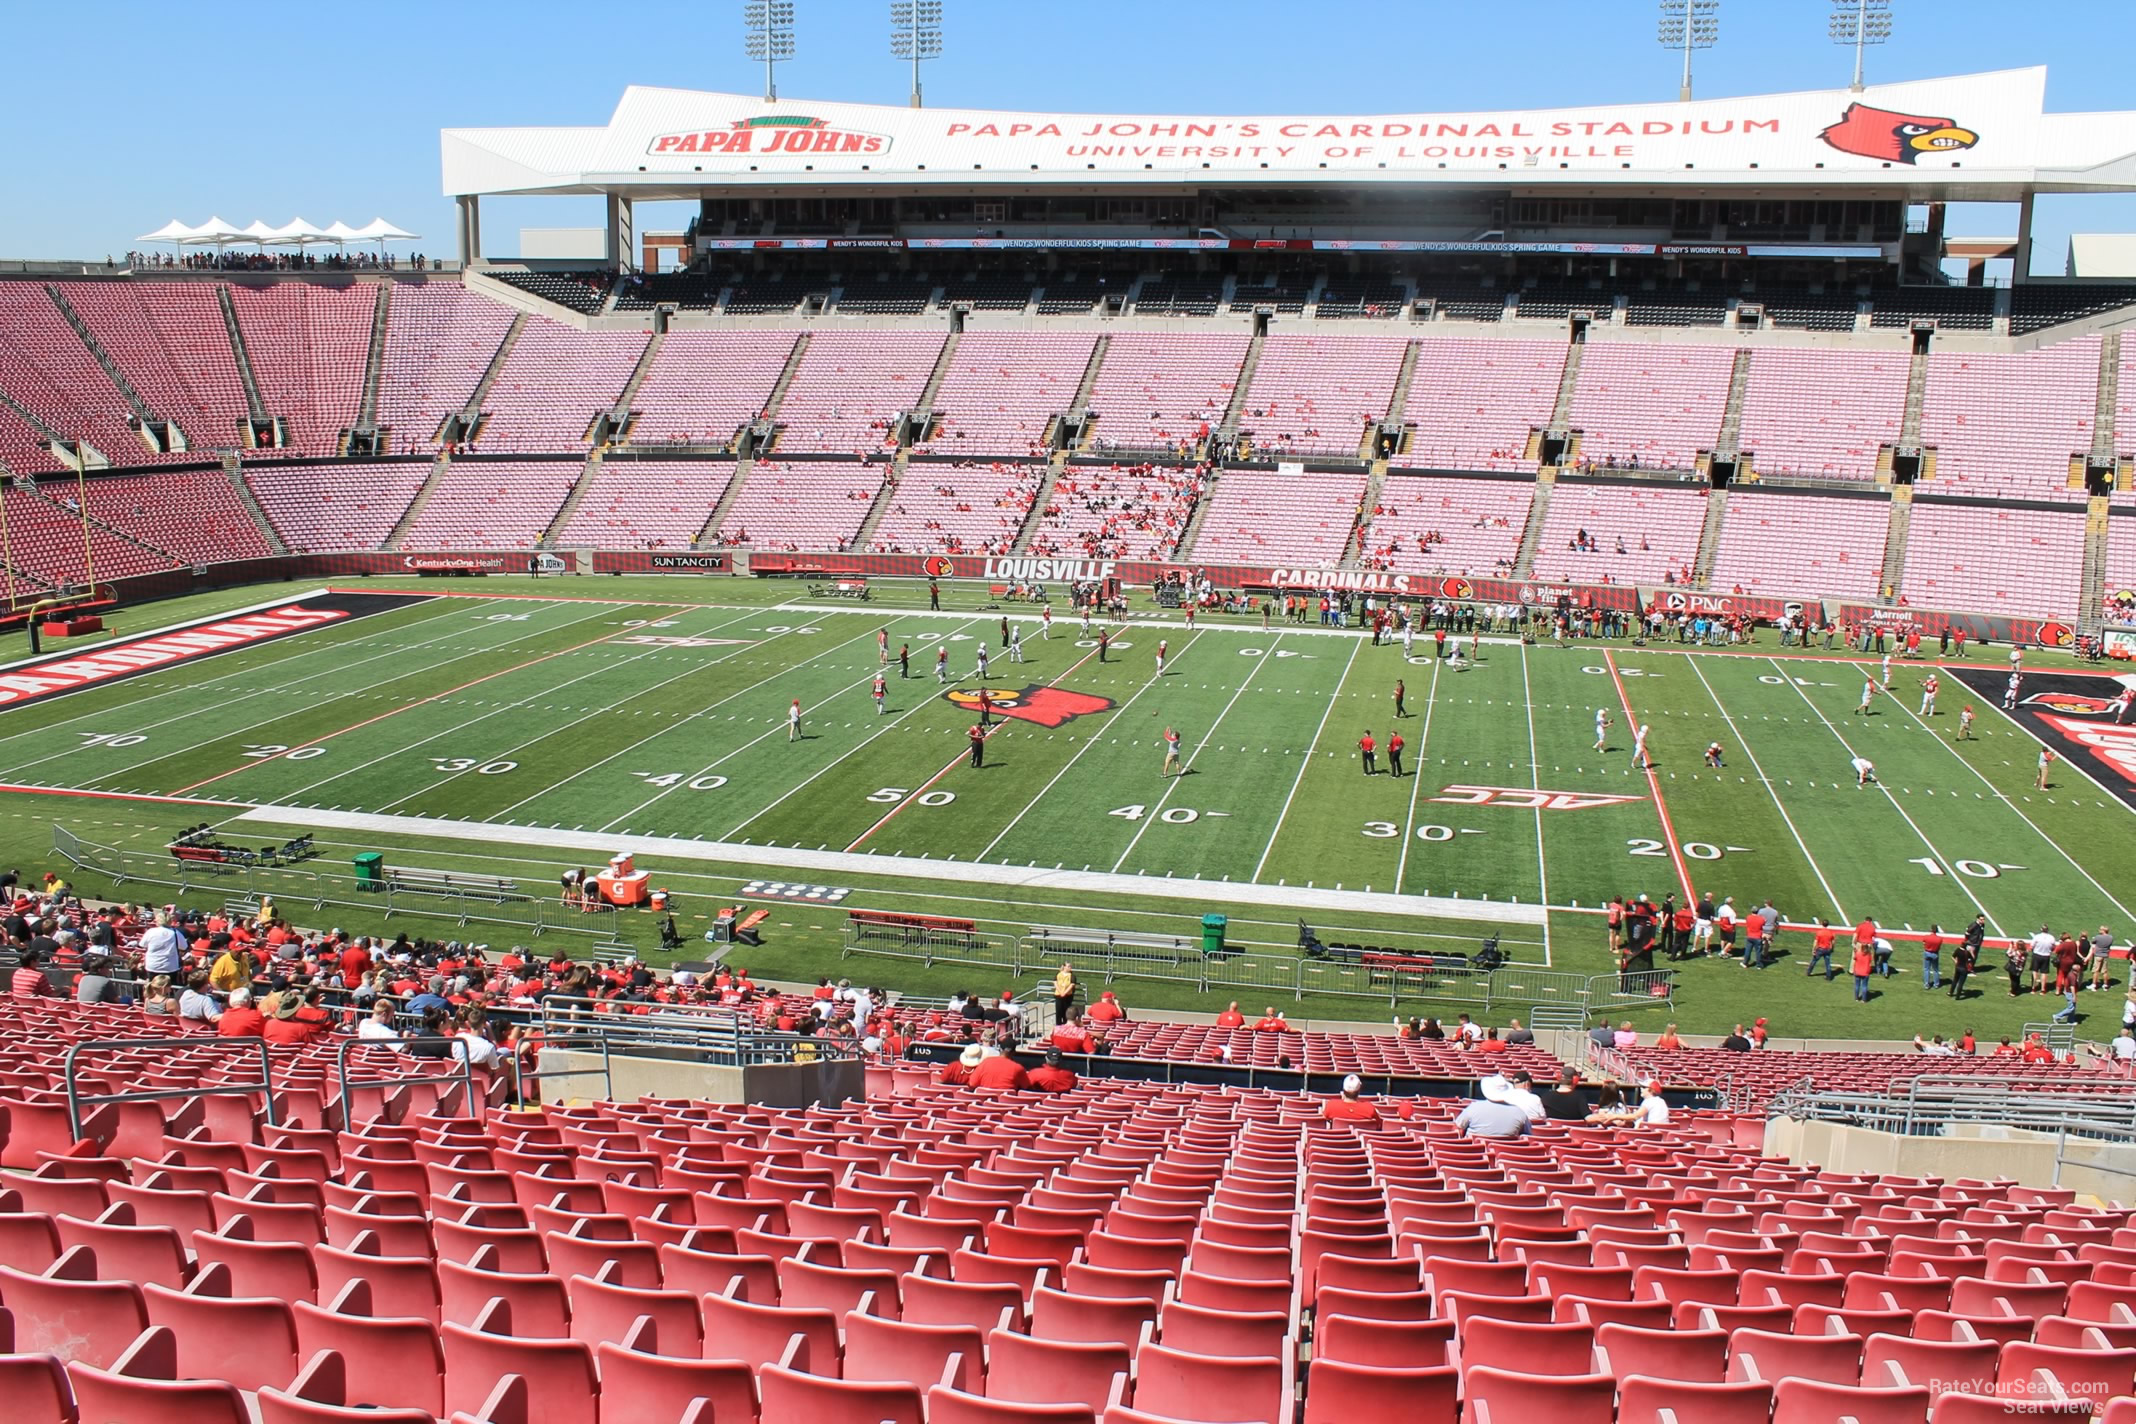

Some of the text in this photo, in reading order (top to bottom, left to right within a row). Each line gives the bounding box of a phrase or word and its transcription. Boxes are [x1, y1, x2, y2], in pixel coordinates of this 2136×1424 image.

[947, 119, 1780, 137] PAPA JOHN'S CARDINAL STADIUM
[655, 130, 753, 153] PAPA
[1066, 145, 1635, 158] UNIVERSITY OF LOUISVILLE
[1004, 239, 1141, 248] WENDY'S WONDERFUL KIDS SPRING GAME
[1414, 241, 1560, 252] WENDY'S WONDERFUL KIDS SPRING GAME
[1661, 246, 1742, 255] WENDY'S WONDERFUL KIDS
[476, 558, 502, 568] Health
[654, 557, 721, 567] SUN TAN CITY
[983, 558, 1115, 581] LOUISVILLE
[1270, 568, 1410, 592] CARDINALS
[1536, 585, 1573, 597] planet
[1690, 595, 1732, 612] PNC
[1870, 609, 1913, 621] Marriott
[916, 632, 974, 642] 40
[2114, 633, 2136, 645] IG
[1238, 648, 1299, 658] 40
[1580, 665, 1644, 677] 20
[1757, 674, 1815, 686] 10
[80, 733, 148, 748] 10
[243, 744, 328, 761] 20
[435, 757, 518, 776] 30
[643, 771, 729, 791] 40
[866, 787, 958, 807] 50
[1107, 803, 1200, 825] 40
[1360, 820, 1455, 842] 30
[1626, 839, 1724, 861] 20
[1908, 857, 2001, 879] 10
[612, 881, 625, 896] G
[914, 1046, 932, 1056] 105
[1694, 1090, 1713, 1100] 105
